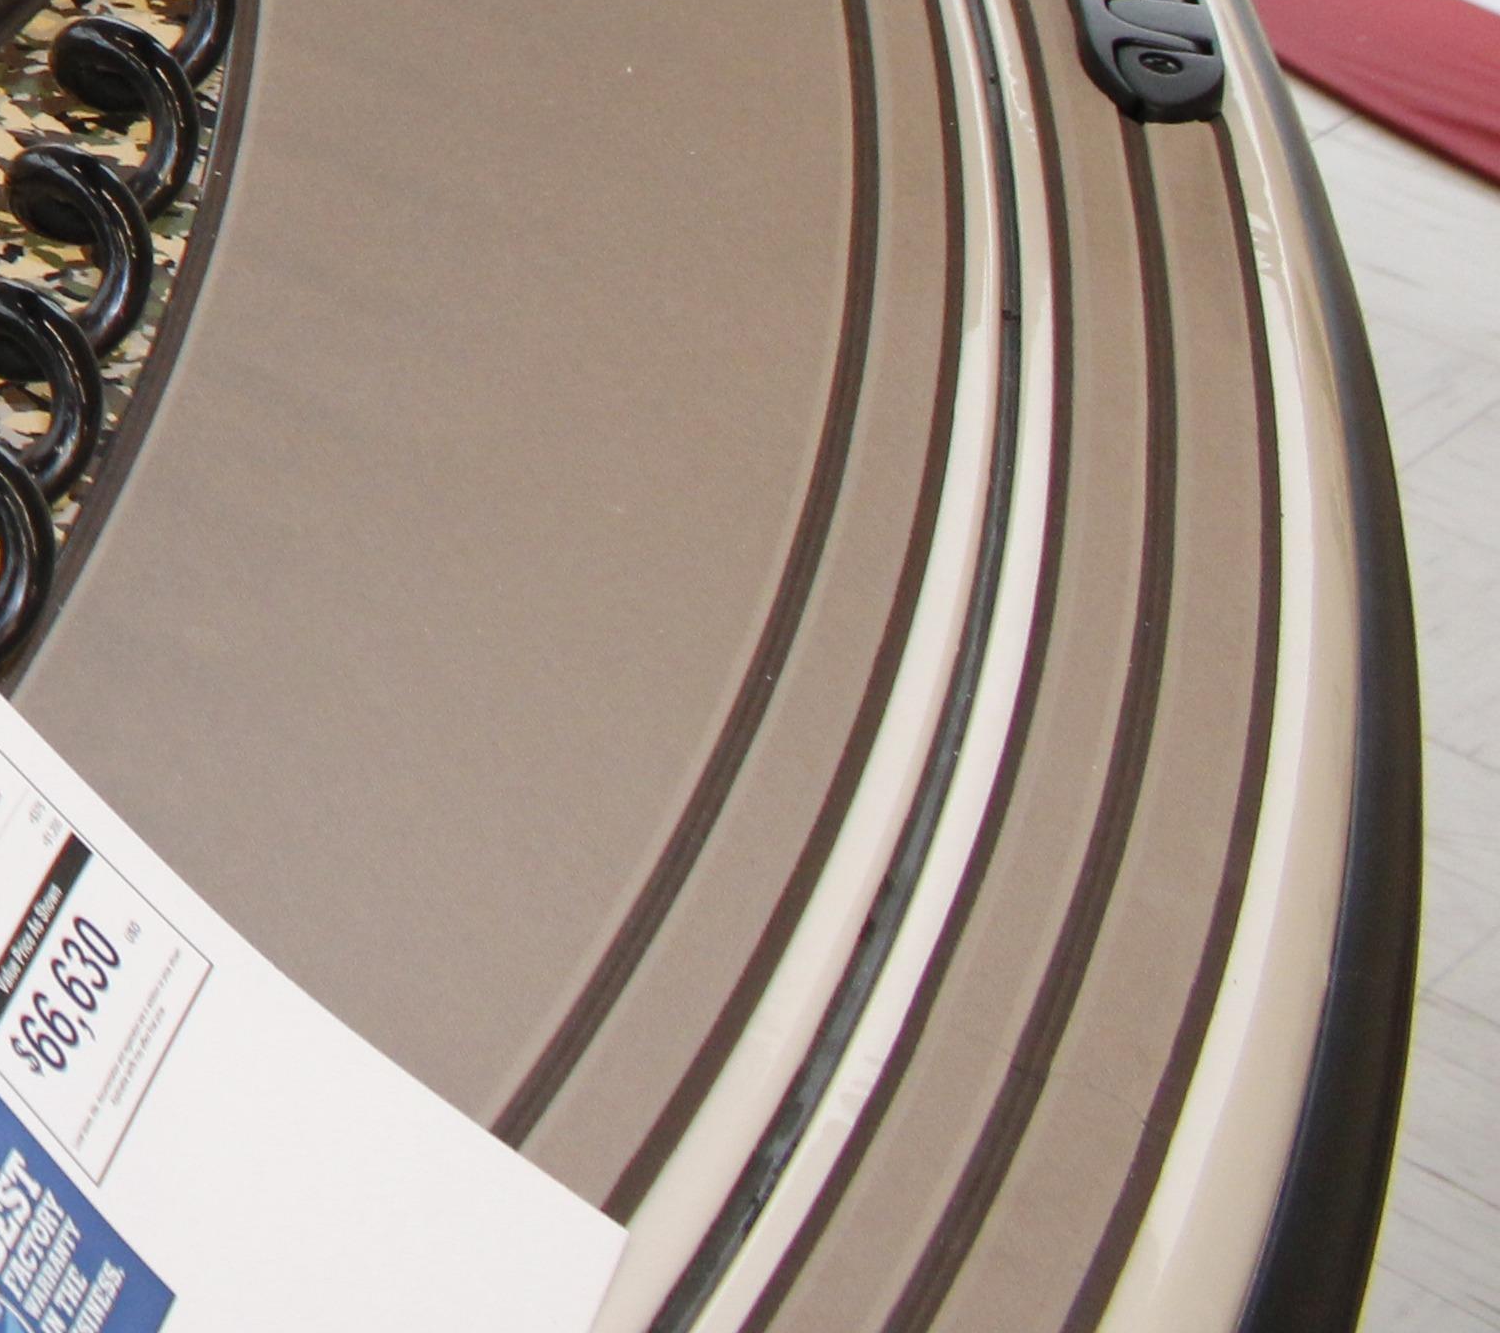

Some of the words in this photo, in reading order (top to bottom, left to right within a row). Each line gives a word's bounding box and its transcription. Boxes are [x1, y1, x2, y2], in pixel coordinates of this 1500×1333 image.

[24, 913, 45, 940] As
[32, 879, 64, 923] Shown
[9, 928, 37, 966] Price
[10, 913, 122, 1073] $66,630
[0, 1189, 67, 1301] FACTORY
[21, 1215, 84, 1323] WARRANTY
[38, 1306, 67, 1333] IN
[51, 1262, 89, 1320] THE
[71, 1253, 127, 1333] SINESS.
